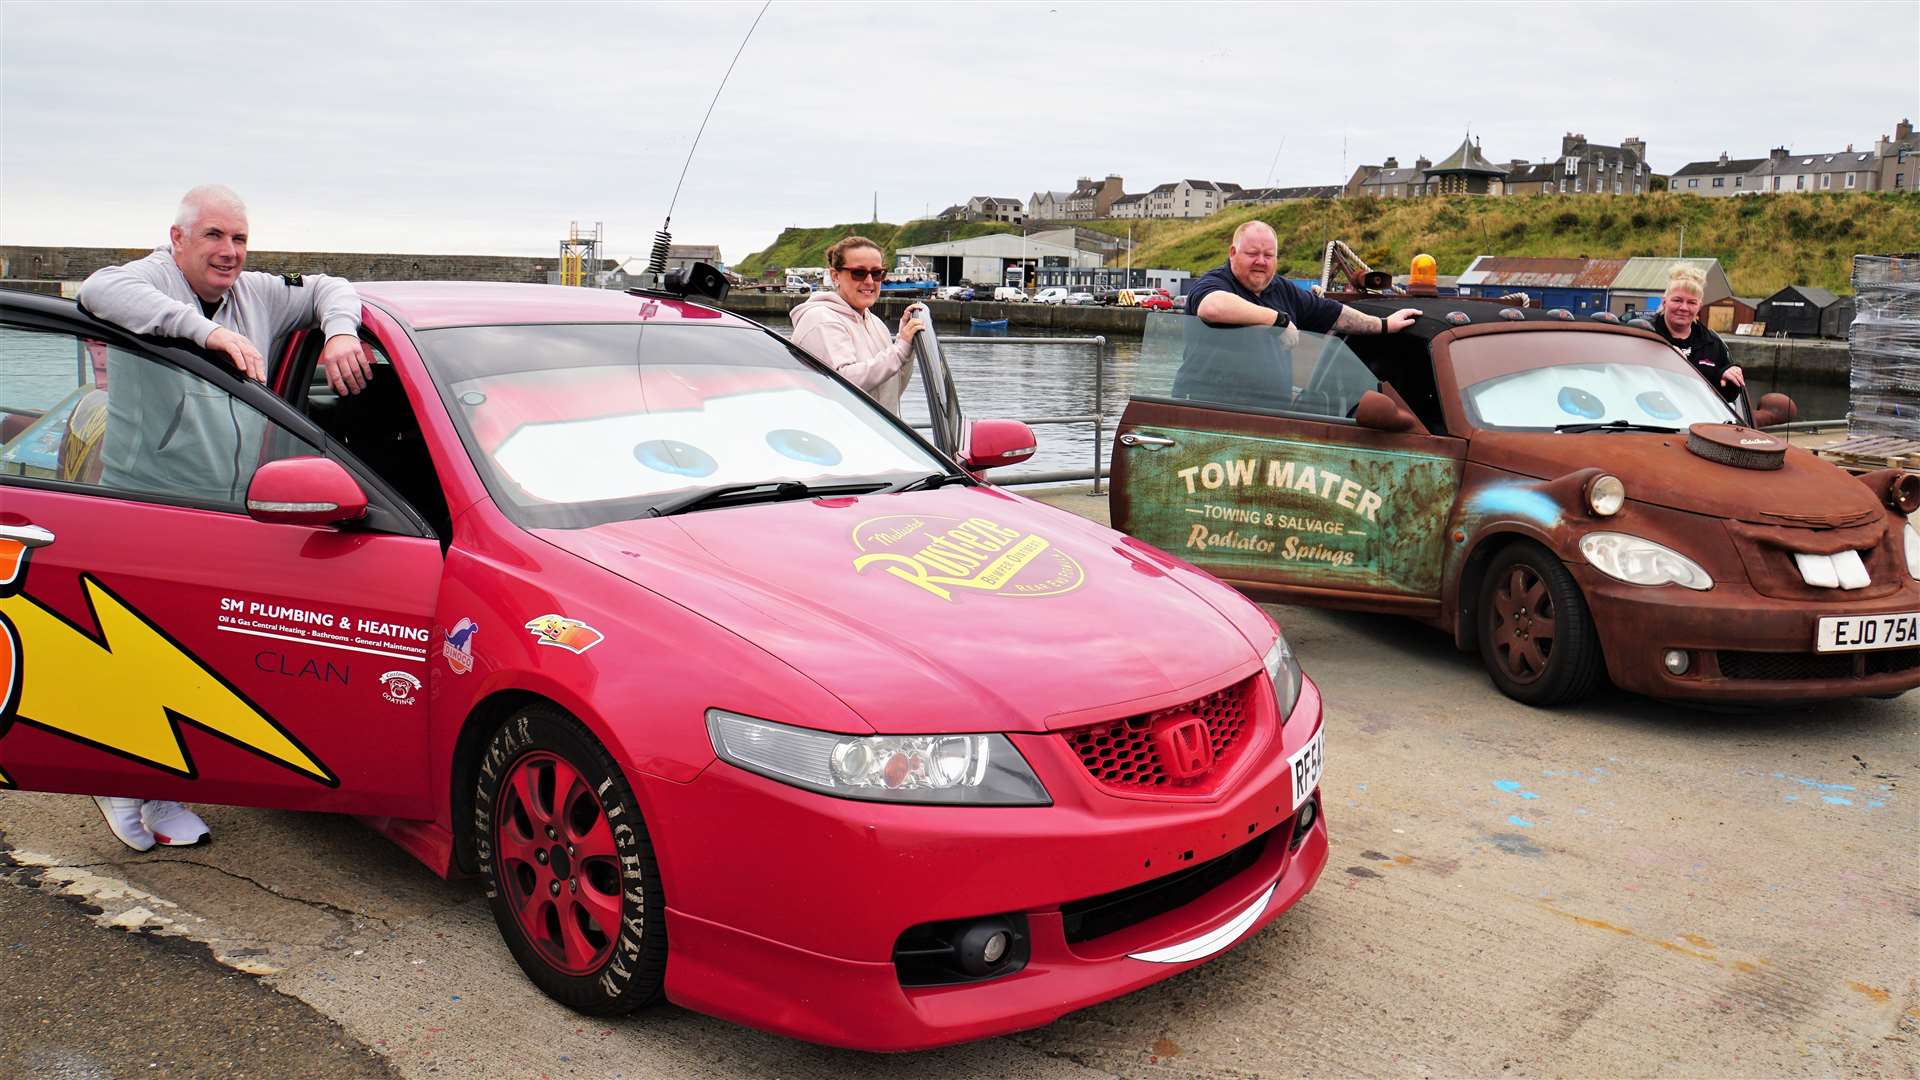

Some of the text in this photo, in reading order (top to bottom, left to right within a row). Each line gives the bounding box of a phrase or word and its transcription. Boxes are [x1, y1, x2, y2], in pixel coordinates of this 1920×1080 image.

[1177, 459, 1382, 522] TOW MATER
[1204, 504, 1345, 536] TOWING & SALVAGE
[1186, 524, 1355, 567] Radiator Springs
[218, 615, 229, 623] Oil
[230, 616, 236, 624] &
[237, 618, 251, 626] Gas
[252, 620, 277, 630] Central
[278, 624, 306, 636] Heating
[311, 629, 349, 642] Bathrooms
[355, 636, 382, 647] General
[383, 641, 427, 655] Maintenance
[220, 597, 429, 643] SM PLUMBING & HEATING
[1884, 617, 1918, 643] 75A
[255, 650, 350, 686] CLAN
[446, 645, 471, 668] DINOCO
[382, 692, 415, 705] COATINGS
